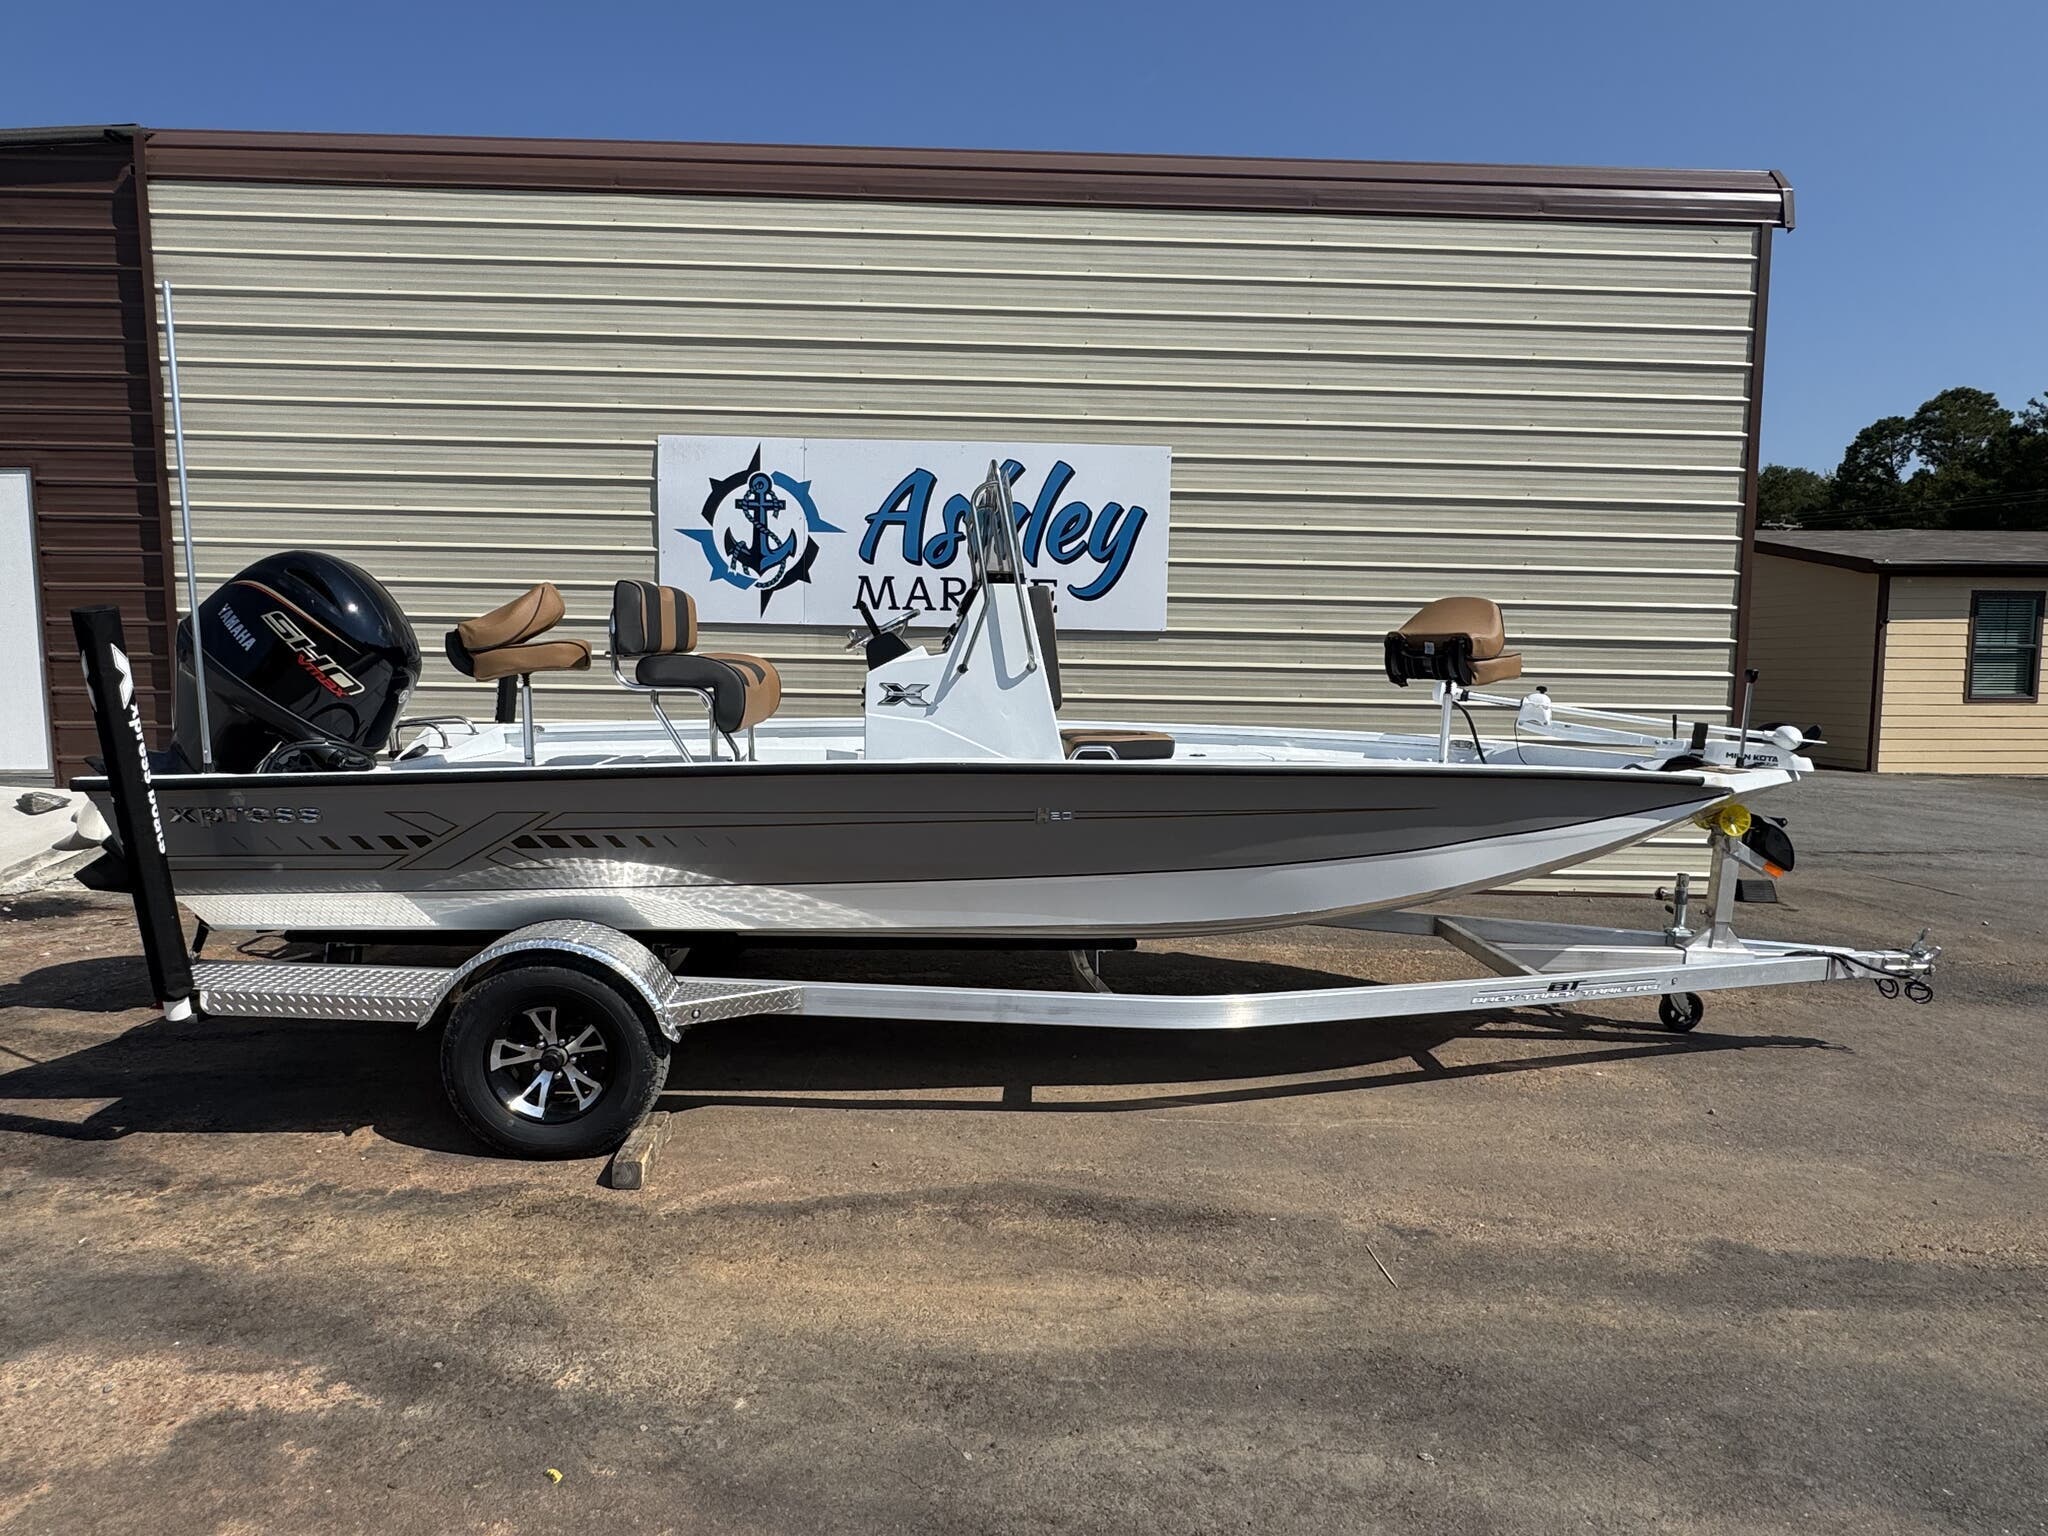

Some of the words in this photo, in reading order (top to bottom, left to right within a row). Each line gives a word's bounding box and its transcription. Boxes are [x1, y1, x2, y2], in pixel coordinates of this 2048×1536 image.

[217, 603, 256, 651] YAMAHA
[260, 611, 365, 696] SHO
[1726, 752, 1751, 760] MIN
[169, 807, 322, 827] xpress
[1472, 995, 1517, 1004] BACK
[1523, 990, 1576, 1000] TRACK
[1582, 984, 1660, 996] TRAILERS
[1547, 980, 1587, 991] BT
